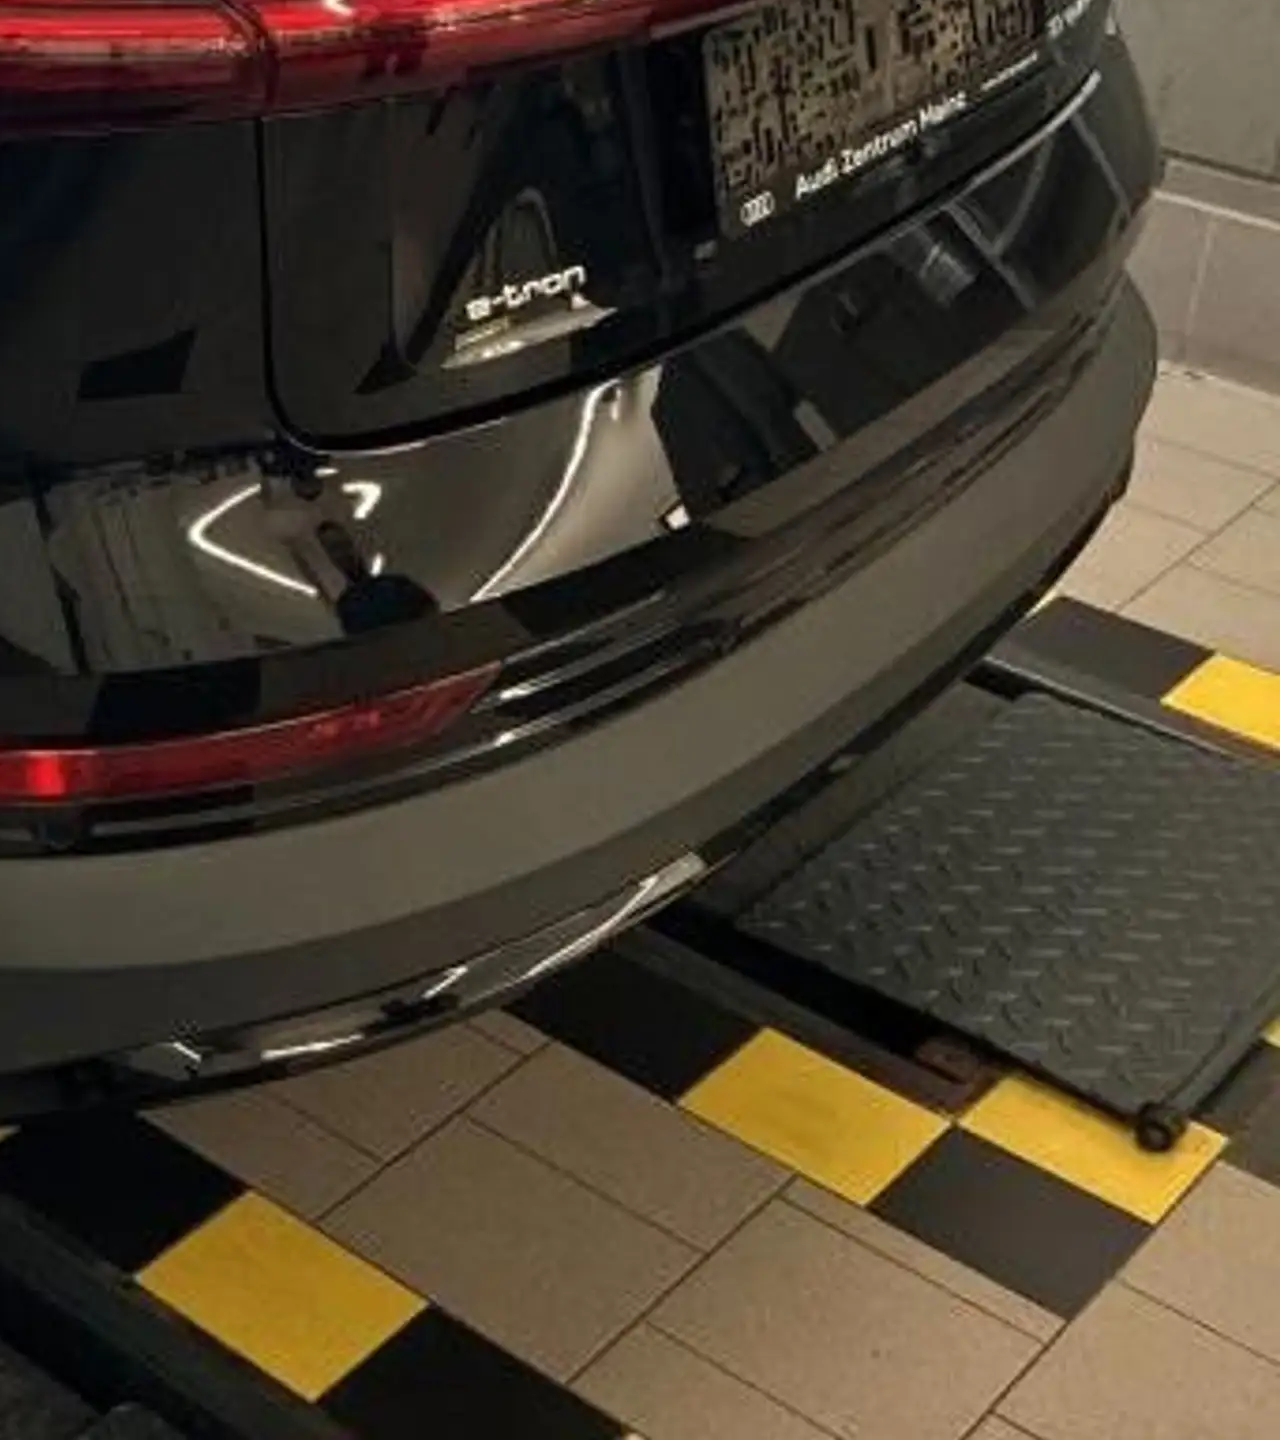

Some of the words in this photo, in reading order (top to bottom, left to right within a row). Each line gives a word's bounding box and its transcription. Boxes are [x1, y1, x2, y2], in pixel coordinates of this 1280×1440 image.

[796, 157, 838, 200] Audi
[840, 118, 917, 175] Zentrum
[465, 264, 587, 321] e-tron
